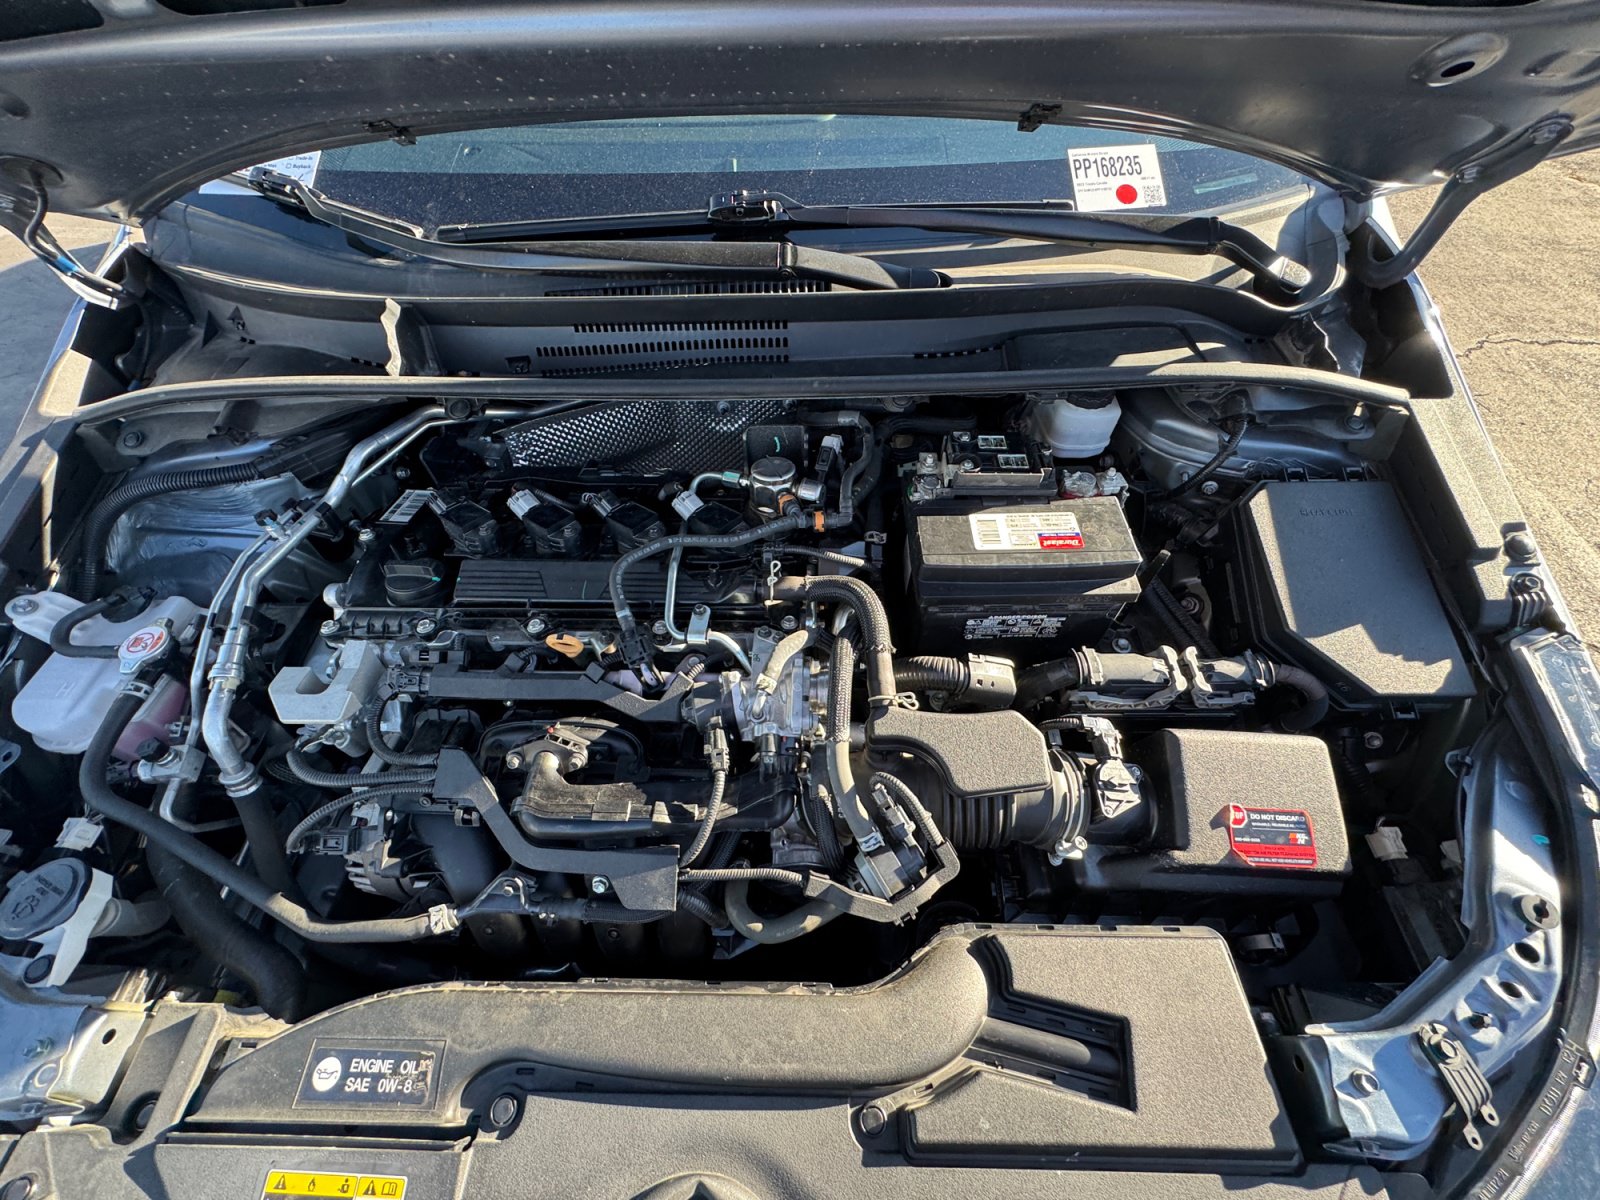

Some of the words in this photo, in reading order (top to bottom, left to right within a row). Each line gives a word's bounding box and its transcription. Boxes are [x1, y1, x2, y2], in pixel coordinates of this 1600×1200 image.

[1073, 155, 1142, 179] PP168235
[1043, 539, 1080, 547] Duralast
[1275, 814, 1305, 822] DISCARD
[349, 1058, 395, 1073] ENGINE
[400, 1060, 419, 1074] OIL
[344, 1077, 371, 1093] SAE
[377, 1078, 412, 1093] 0W-8
